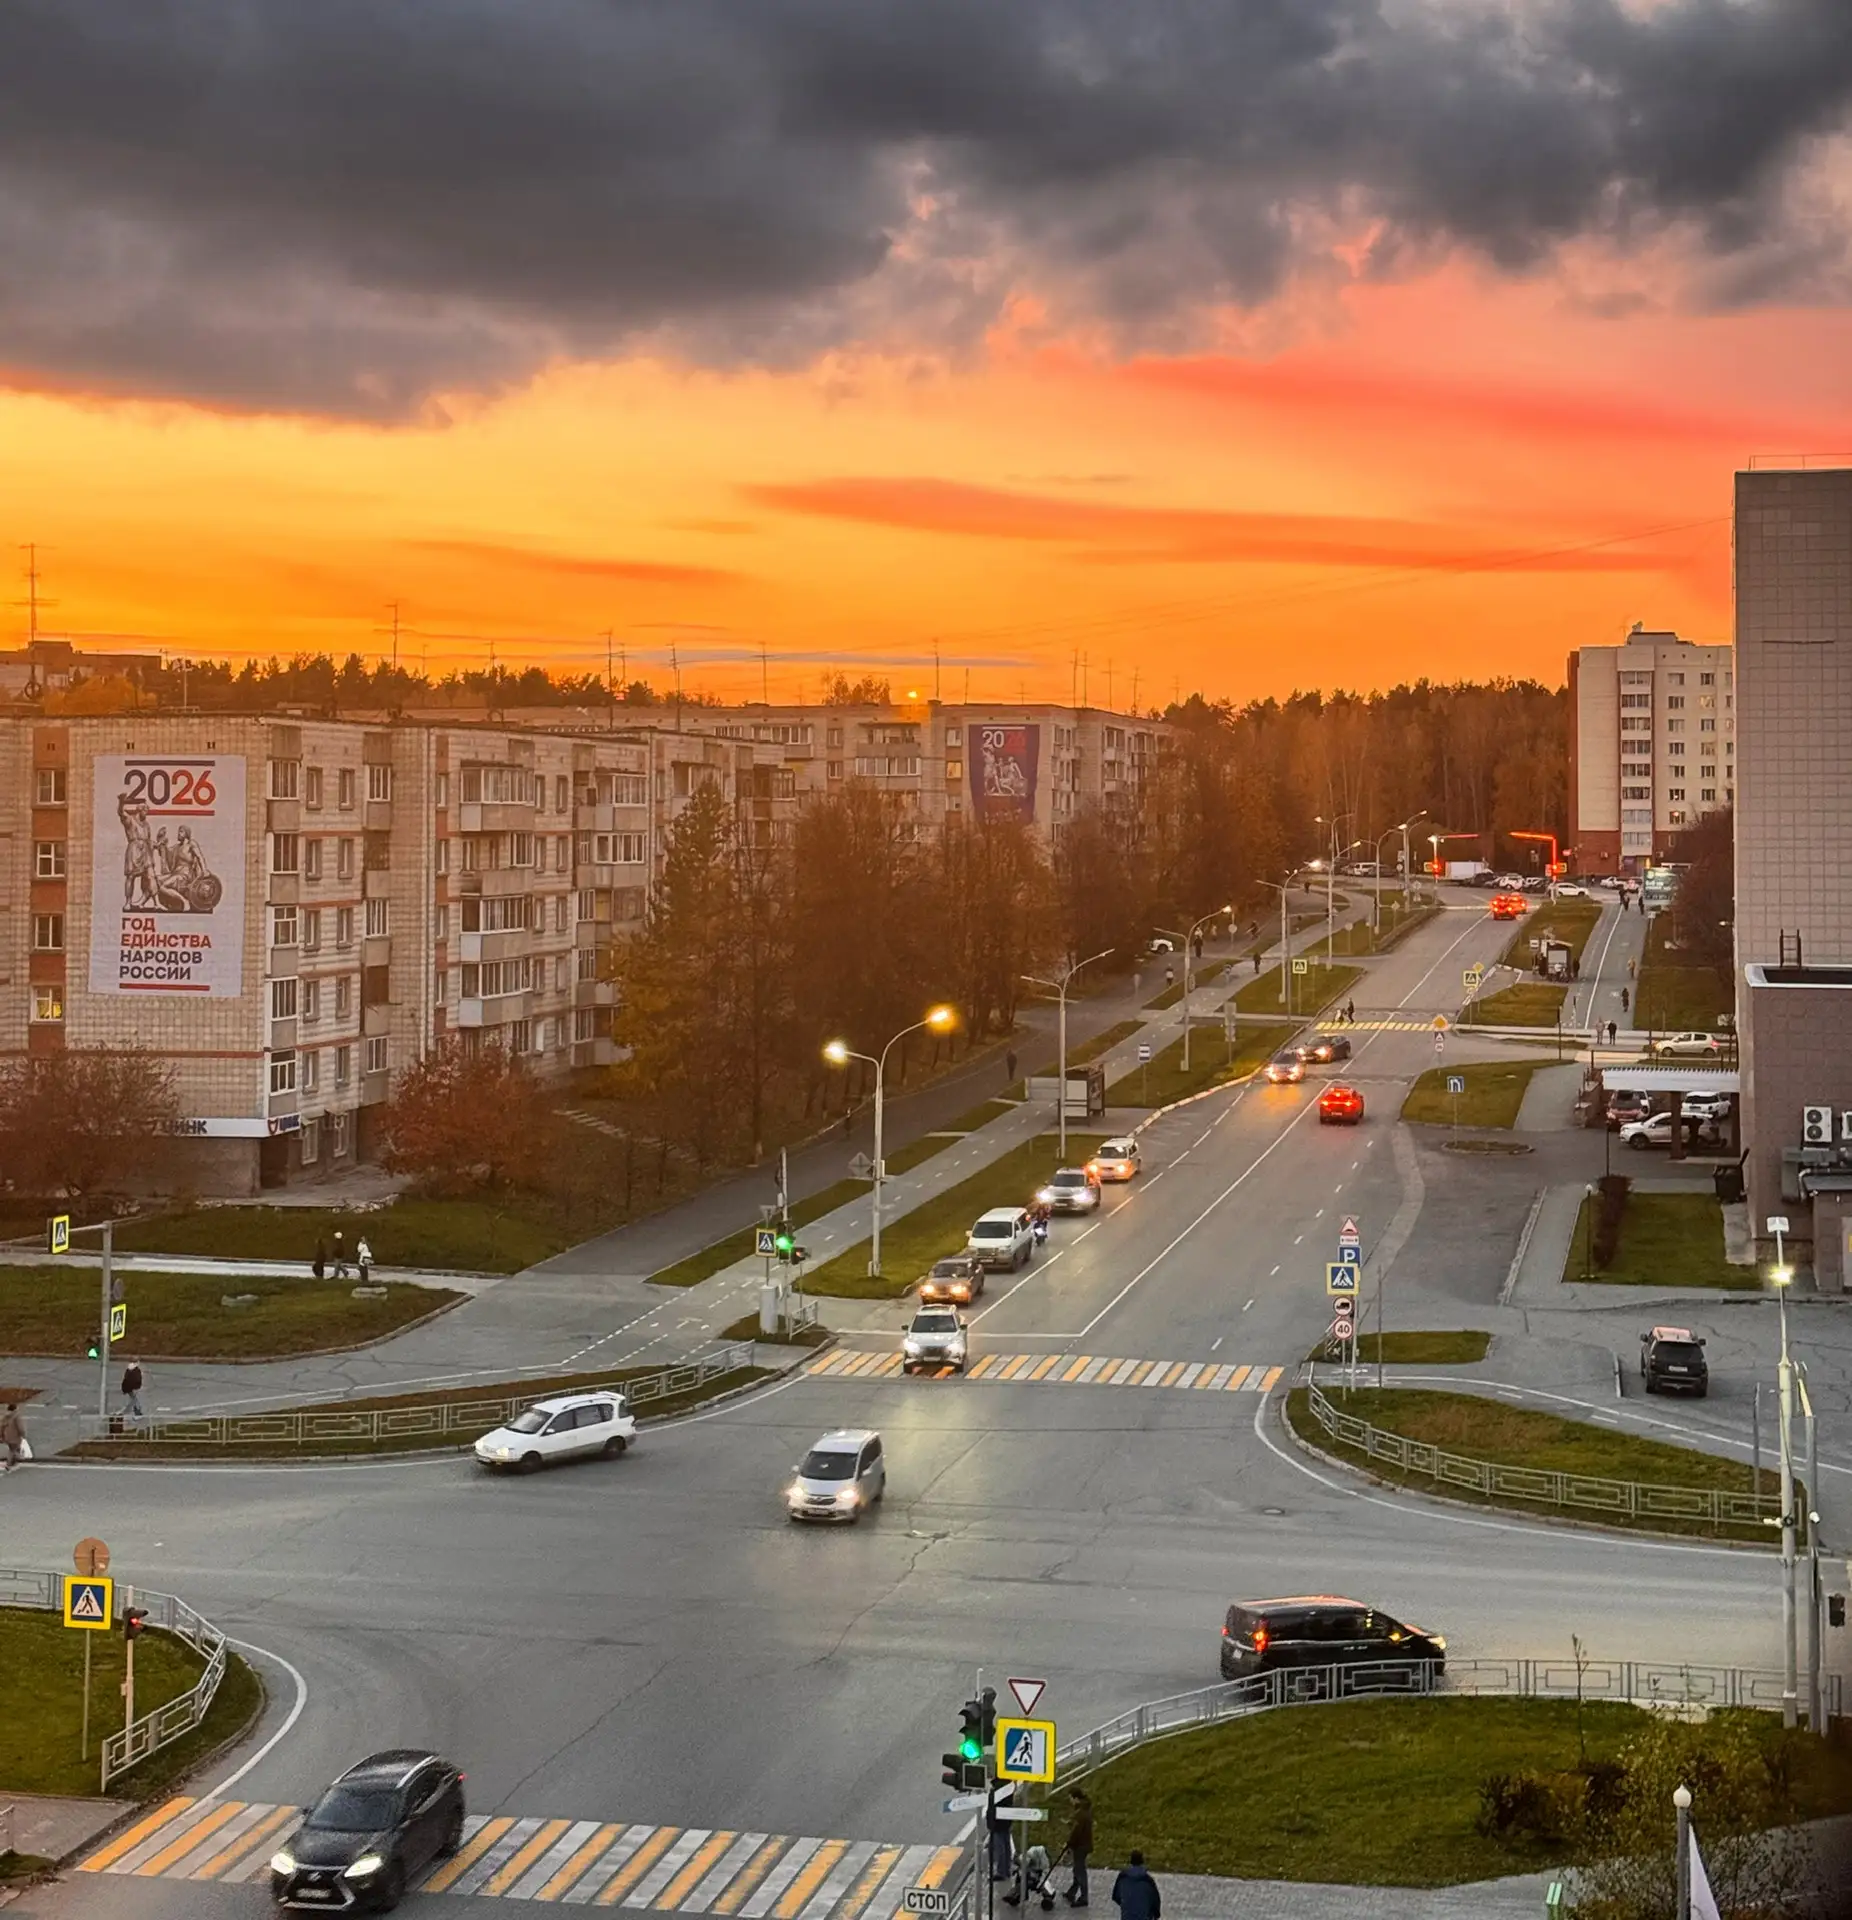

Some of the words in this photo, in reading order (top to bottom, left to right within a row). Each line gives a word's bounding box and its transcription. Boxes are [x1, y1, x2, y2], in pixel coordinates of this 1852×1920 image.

[124, 769, 216, 806] 2026
[122, 917, 156, 933] ГОД
[121, 933, 212, 949] ЕДИНСТВА
[120, 950, 203, 965] НАРОДОВ
[119, 965, 191, 980] РОССИИ
[1344, 1249, 1356, 1263] P
[1337, 1324, 1350, 1334] 40
[907, 1892, 946, 1910] СТОП
